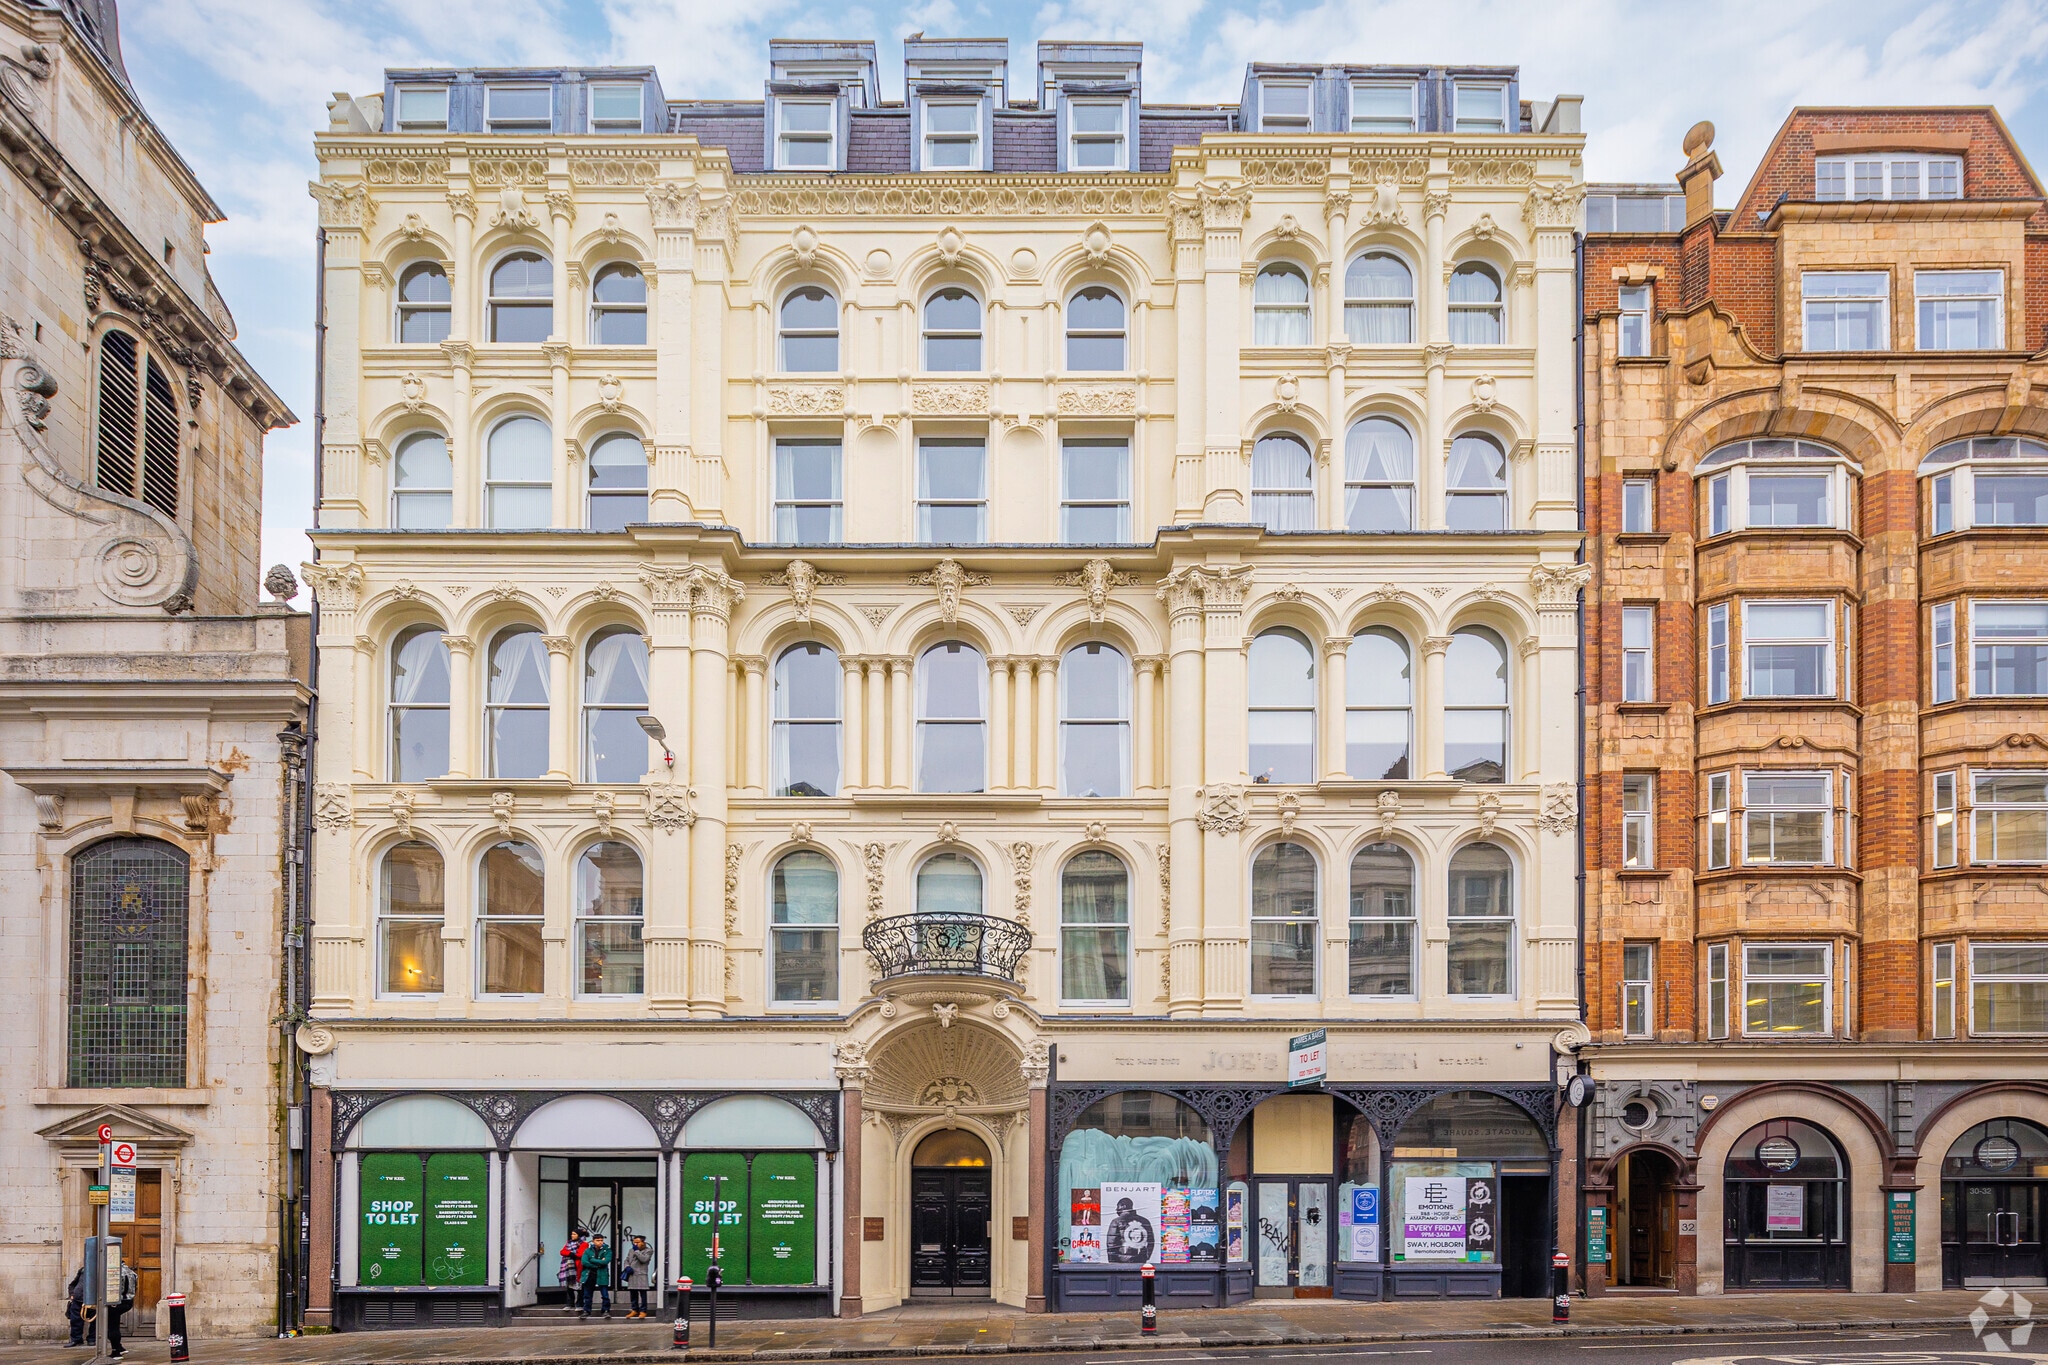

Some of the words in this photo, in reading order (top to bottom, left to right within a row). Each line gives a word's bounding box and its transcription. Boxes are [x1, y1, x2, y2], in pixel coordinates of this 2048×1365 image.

[1292, 1035, 1307, 1045] JAMES
[1312, 1030, 1324, 1039] BAKER
[1300, 1054, 1308, 1063] TO
[1310, 1050, 1320, 1061] LET
[102, 1127, 111, 1139] G
[371, 1201, 413, 1212] SHOP
[365, 1213, 387, 1225] TO
[390, 1213, 419, 1225] LET
[689, 1213, 710, 1225] TO
[1682, 1223, 1695, 1231] 32
[1072, 1240, 1100, 1249] CAMPER
